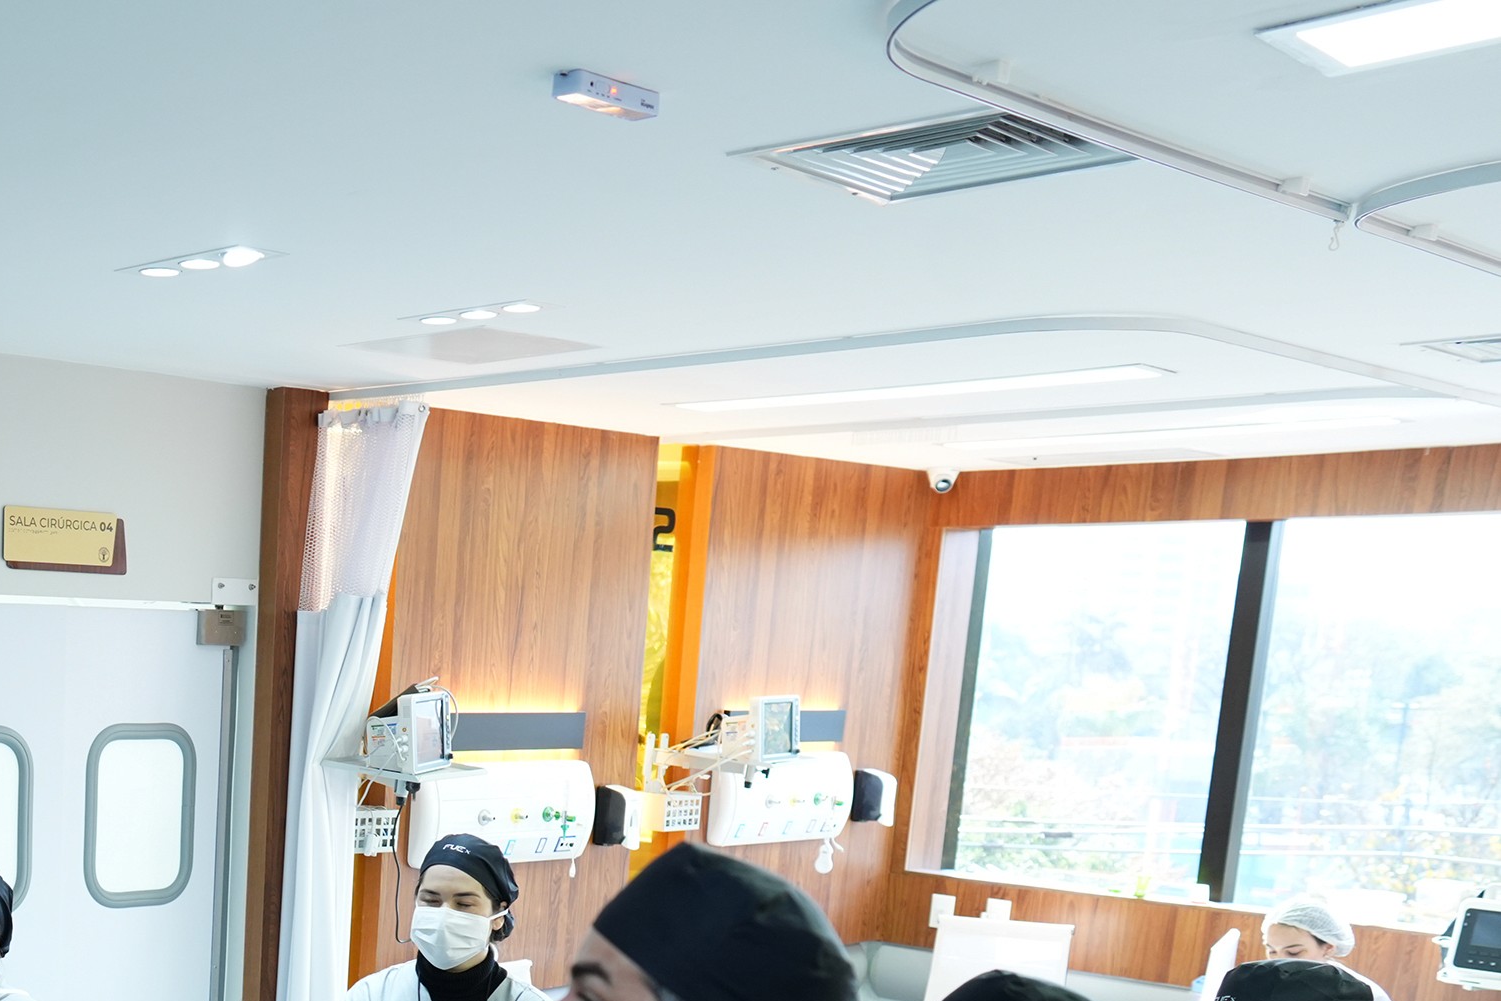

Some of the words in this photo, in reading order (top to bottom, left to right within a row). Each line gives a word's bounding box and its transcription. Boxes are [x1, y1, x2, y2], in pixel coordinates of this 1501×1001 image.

[9, 515, 37, 528] SALA
[39, 517, 97, 532] CIRÚRGICA
[99, 521, 114, 532] 04
